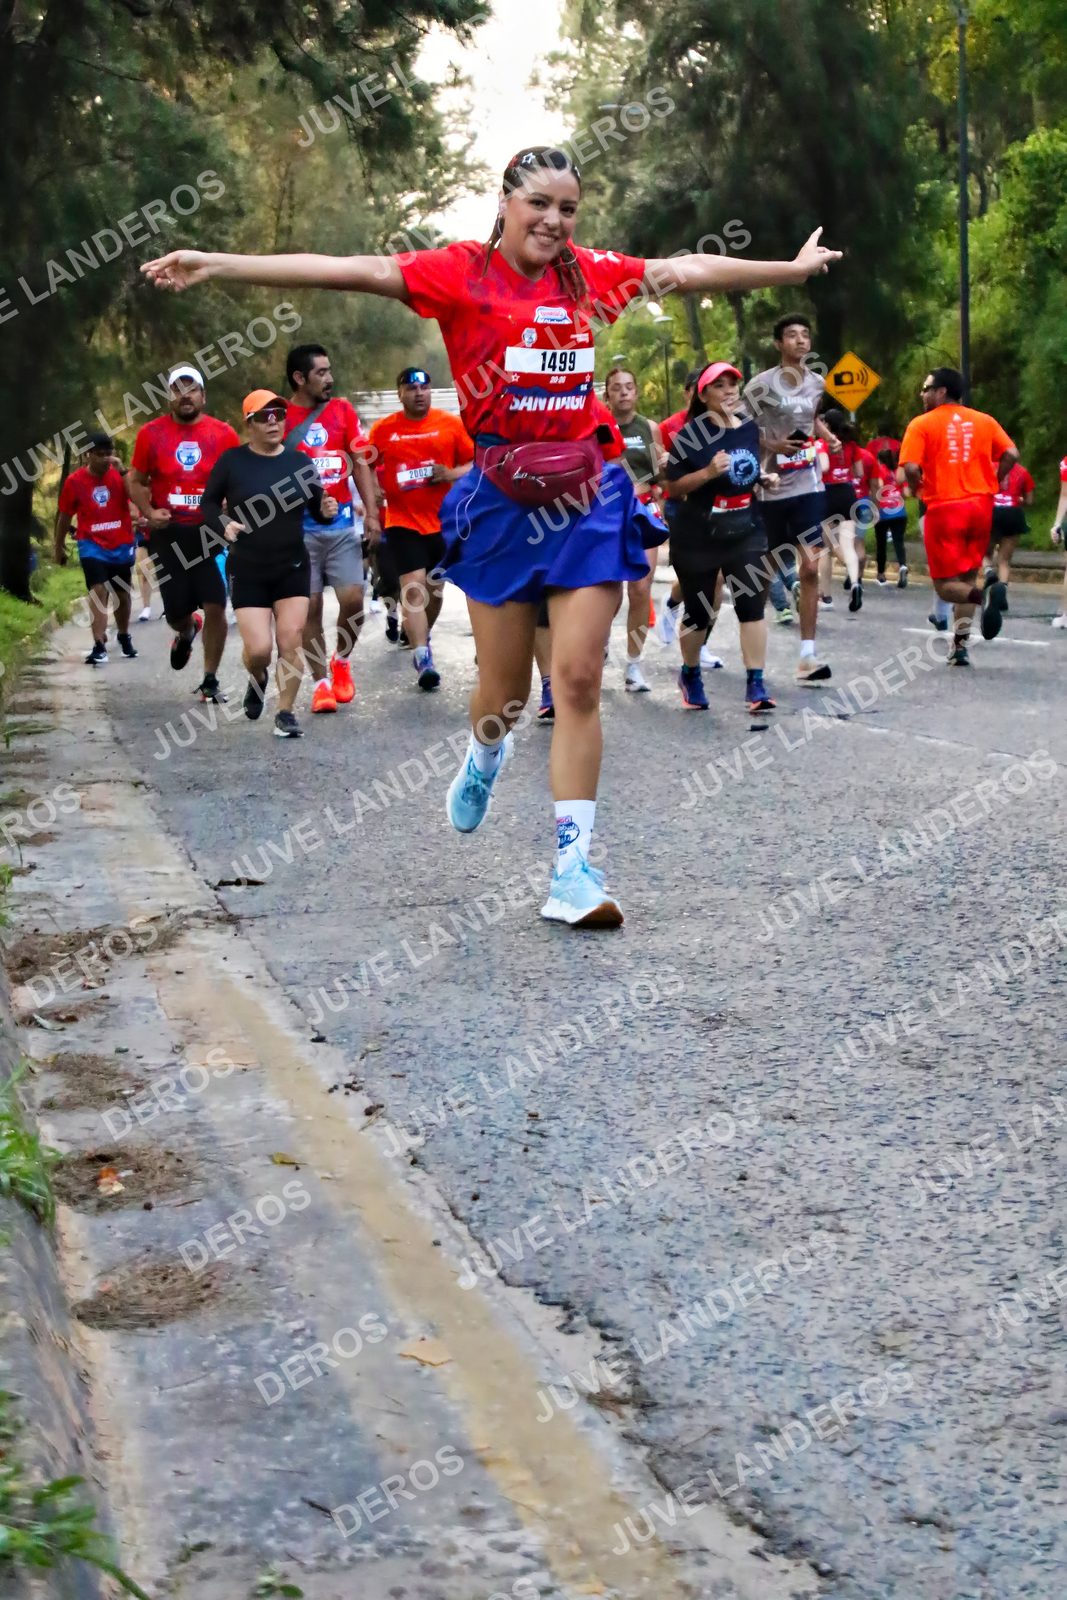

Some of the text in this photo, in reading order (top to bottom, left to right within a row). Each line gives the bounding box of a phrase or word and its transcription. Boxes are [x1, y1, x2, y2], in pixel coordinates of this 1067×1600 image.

[541, 351, 576, 372] 1499
[409, 468, 428, 479] 2002
[91, 520, 122, 532] SANTIAGO
